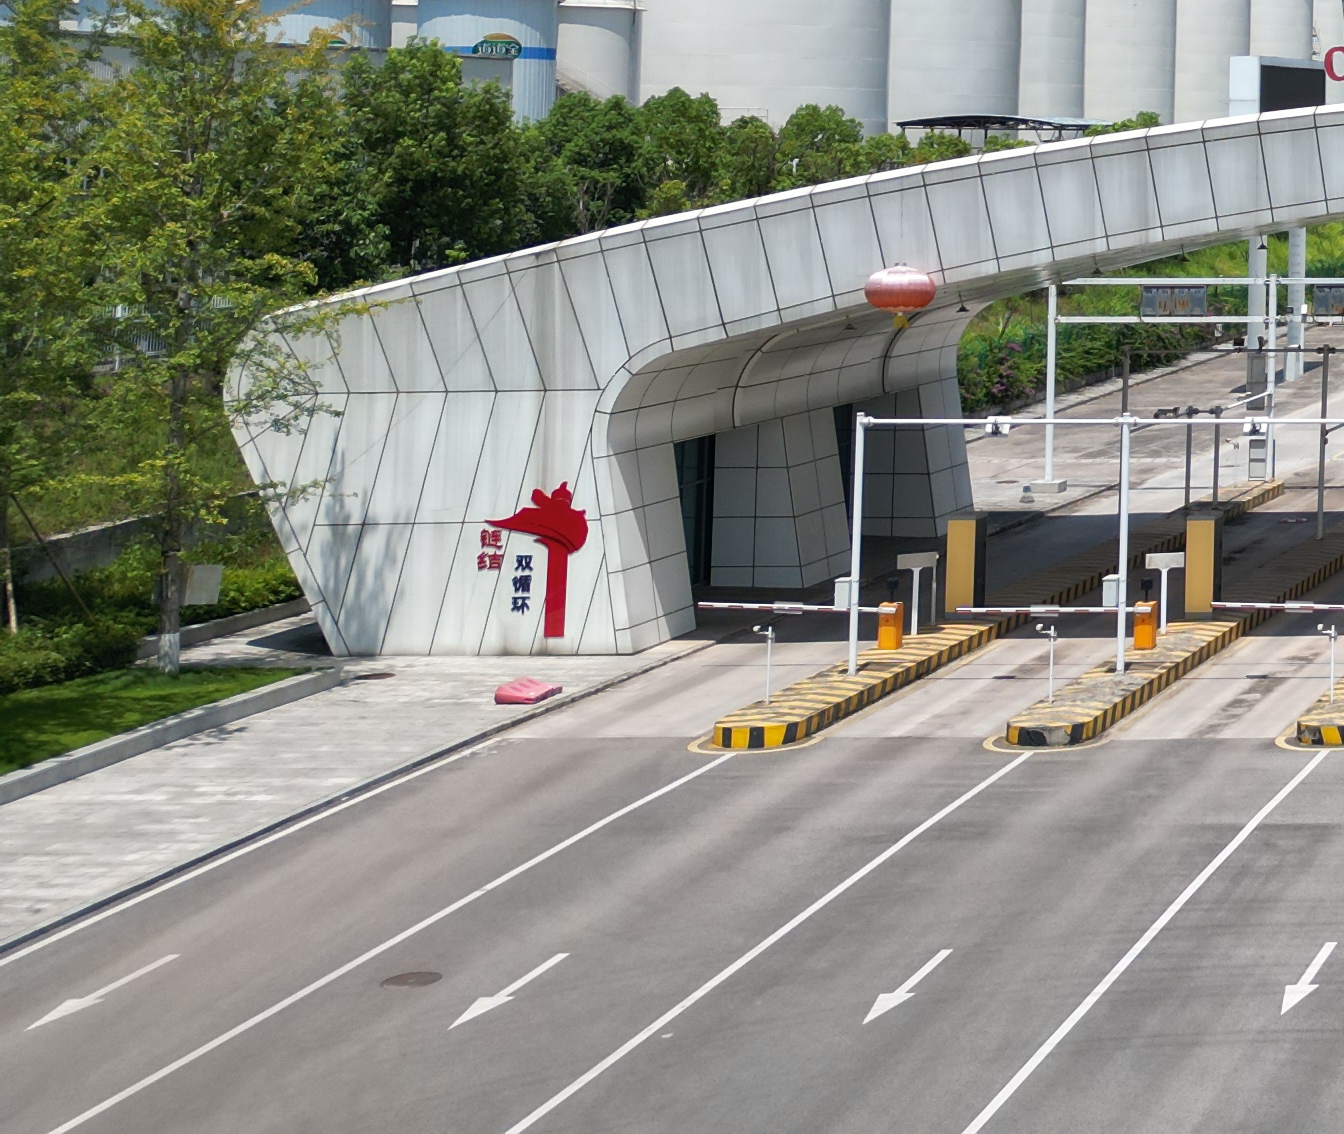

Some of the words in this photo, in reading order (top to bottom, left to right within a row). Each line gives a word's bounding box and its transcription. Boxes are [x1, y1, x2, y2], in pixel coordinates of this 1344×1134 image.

[477, 528, 504, 572] 链结
[511, 554, 533, 615] 双循环
